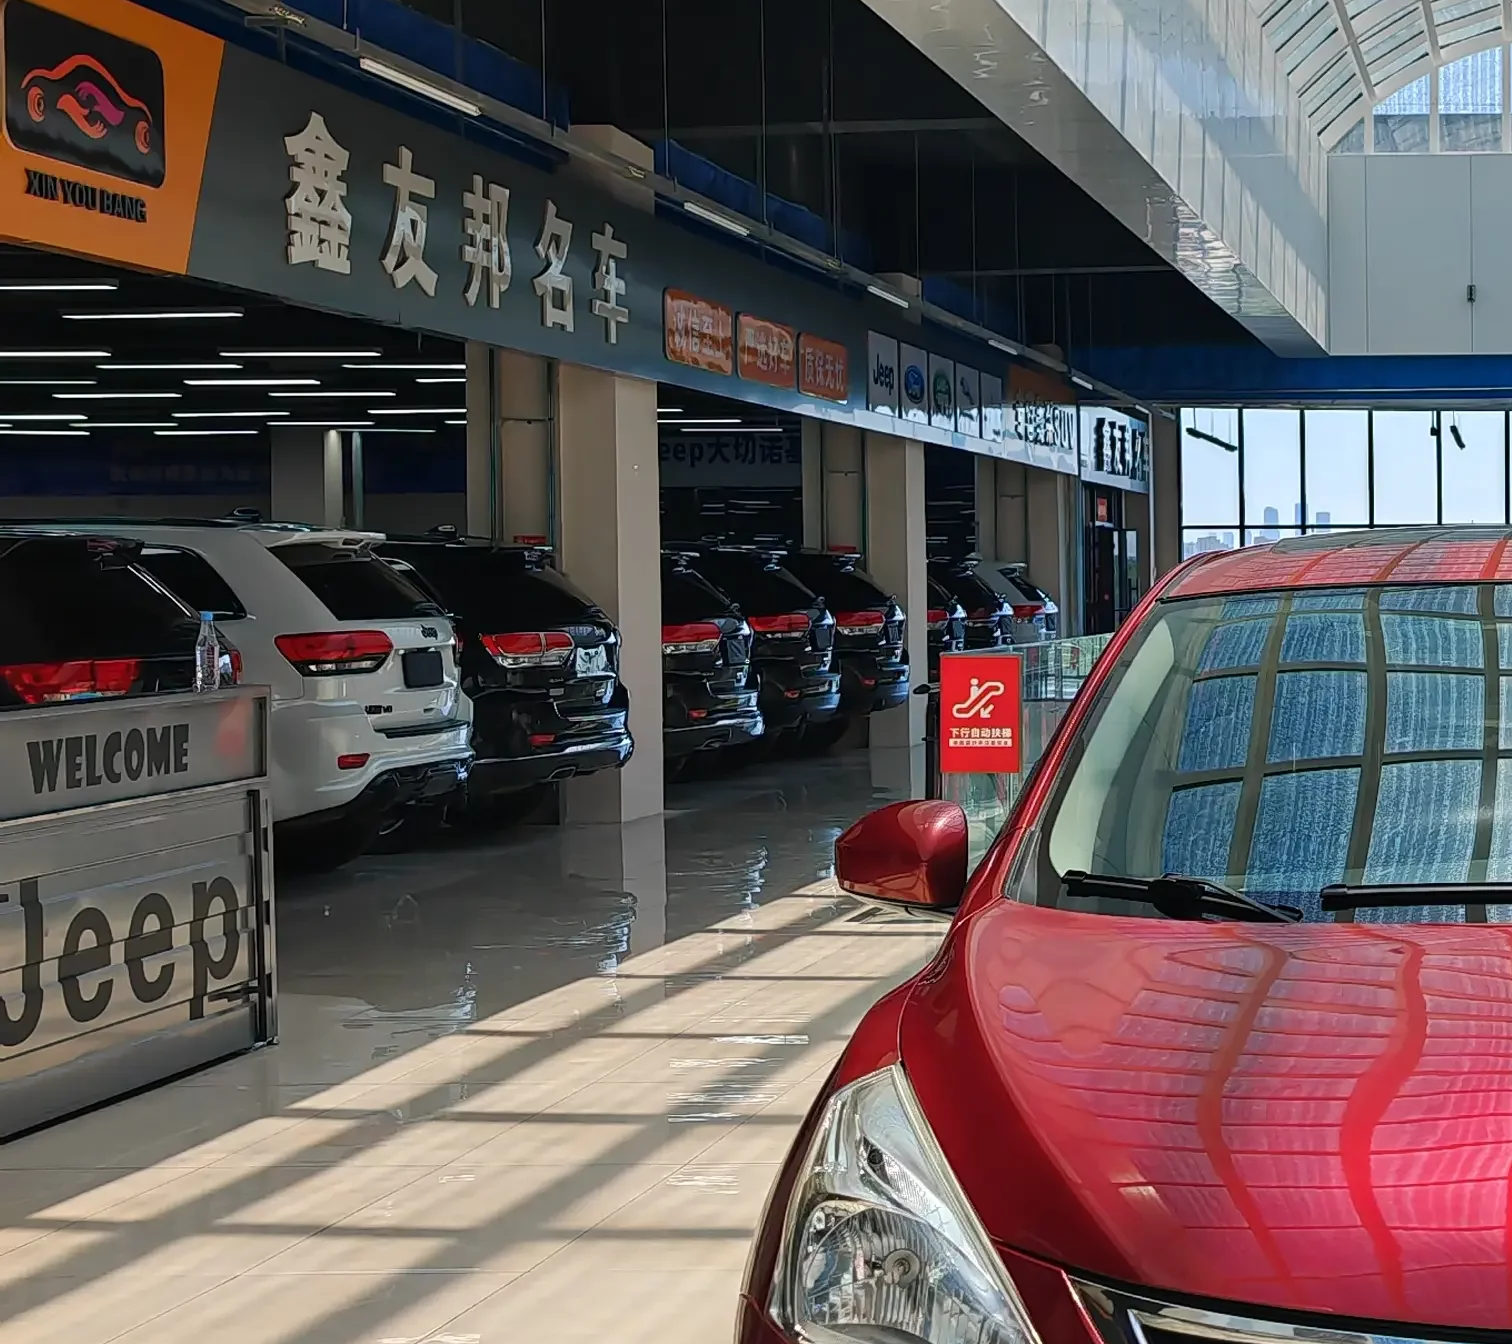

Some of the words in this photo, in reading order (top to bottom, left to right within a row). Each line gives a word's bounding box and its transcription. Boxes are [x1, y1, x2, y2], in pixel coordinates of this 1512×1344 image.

[24, 168, 58, 201] XIN
[60, 178, 97, 210] YOU
[99, 189, 147, 222] BANG
[284, 111, 629, 344] 鑫友邦名车
[873, 353, 894, 395] Jeep
[27, 723, 190, 794] WELCOME
[949, 727, 1012, 739] 下行自动扶梯
[0, 876, 240, 1047] Jeep
